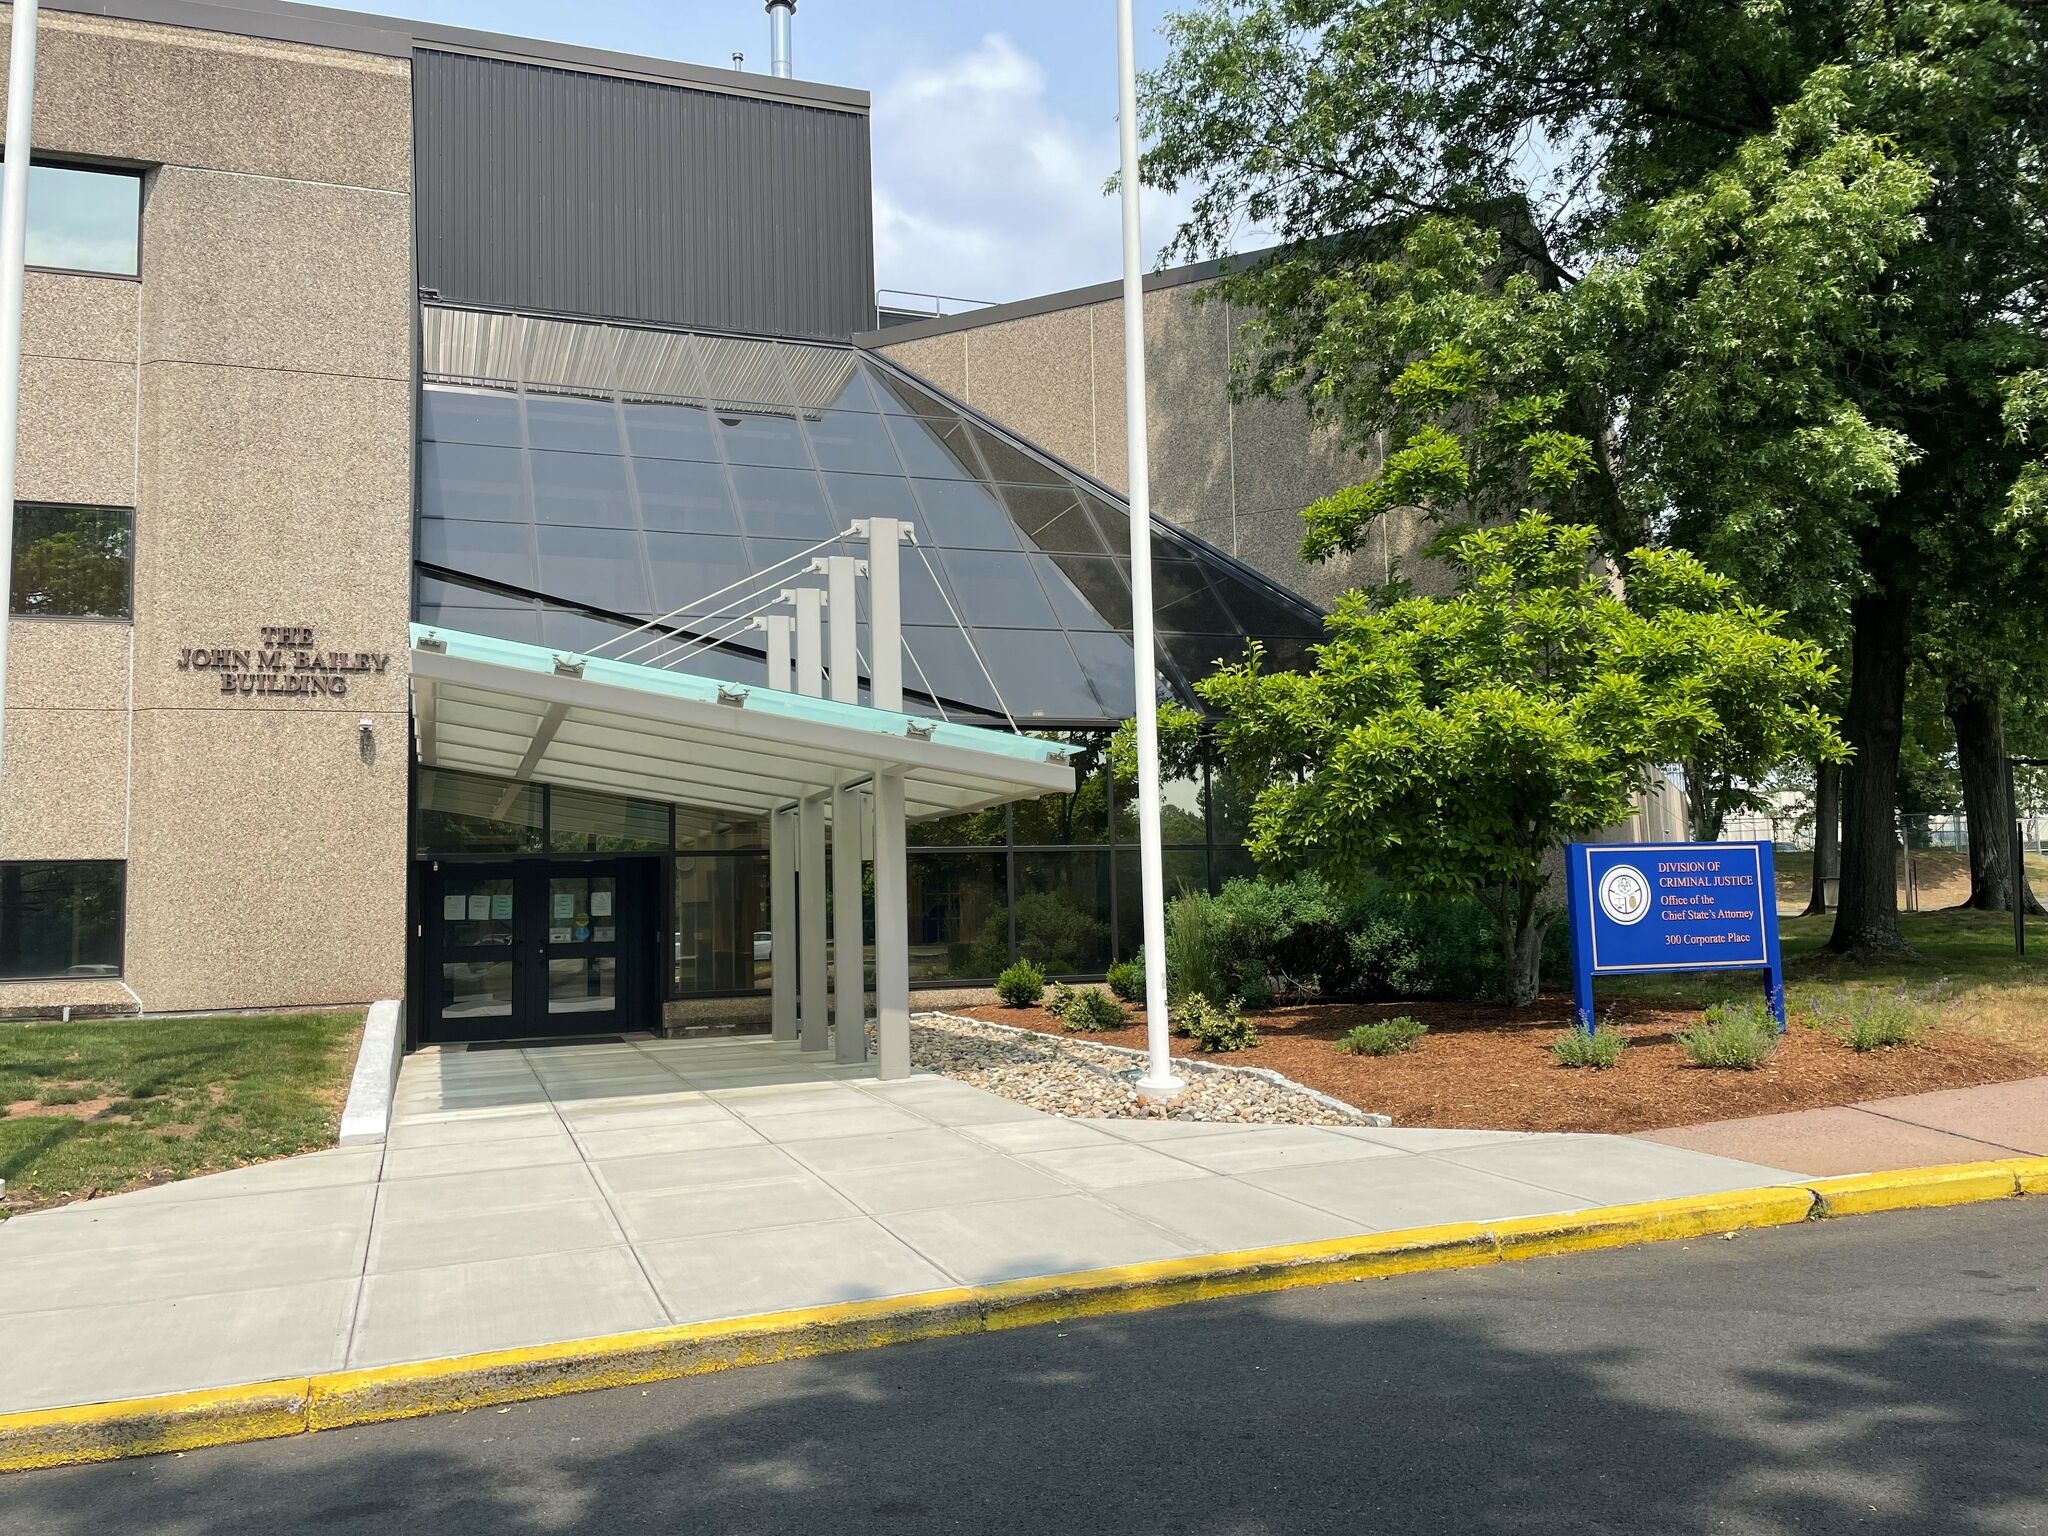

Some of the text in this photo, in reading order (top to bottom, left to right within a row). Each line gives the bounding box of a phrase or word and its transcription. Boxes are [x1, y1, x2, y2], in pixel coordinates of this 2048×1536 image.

[261, 627, 313, 647] THE
[178, 649, 388, 672] JOHN M. BAILEY
[220, 673, 347, 694] BUILDING
[1658, 862, 1721, 873] DIVISION OF
[1659, 875, 1753, 888] CRIMINAL JUSTICE
[1660, 895, 1715, 905] Office of the
[1661, 909, 1754, 921] Chief State's Attorney
[1665, 933, 1751, 947] 300 Corporate Place
